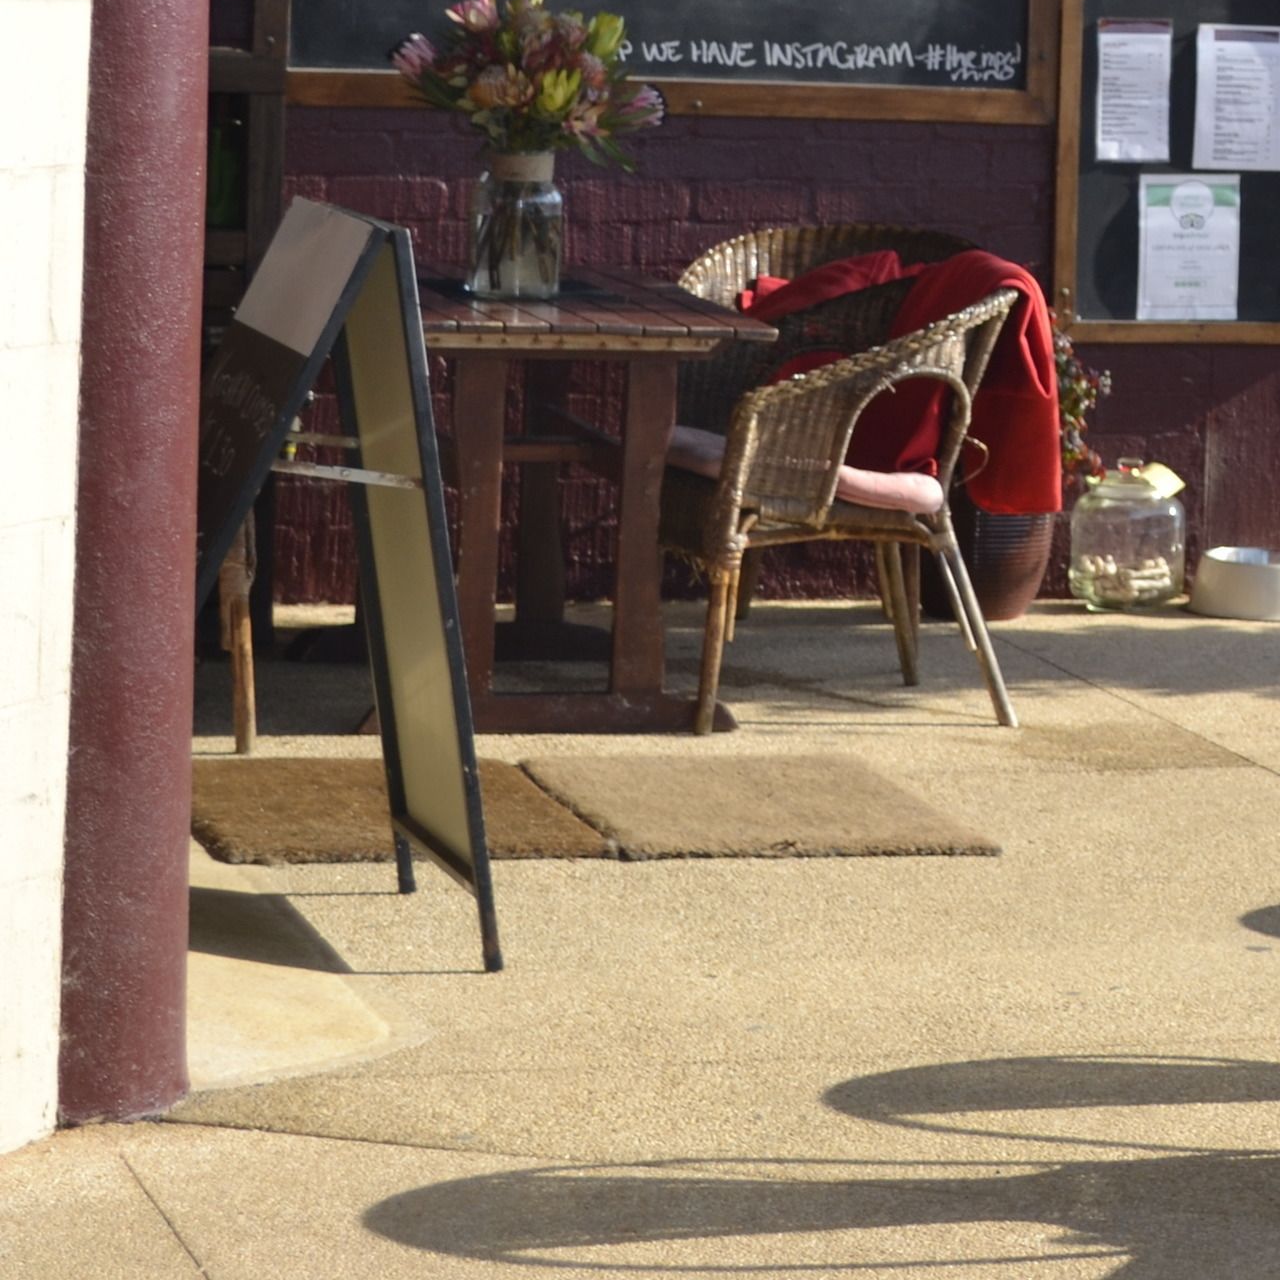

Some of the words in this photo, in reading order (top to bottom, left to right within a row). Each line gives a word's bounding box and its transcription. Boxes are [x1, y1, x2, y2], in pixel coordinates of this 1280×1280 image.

[641, 39, 684, 62] WE
[691, 41, 754, 67] HAVE
[763, 39, 915, 70] INSTAGRAM
